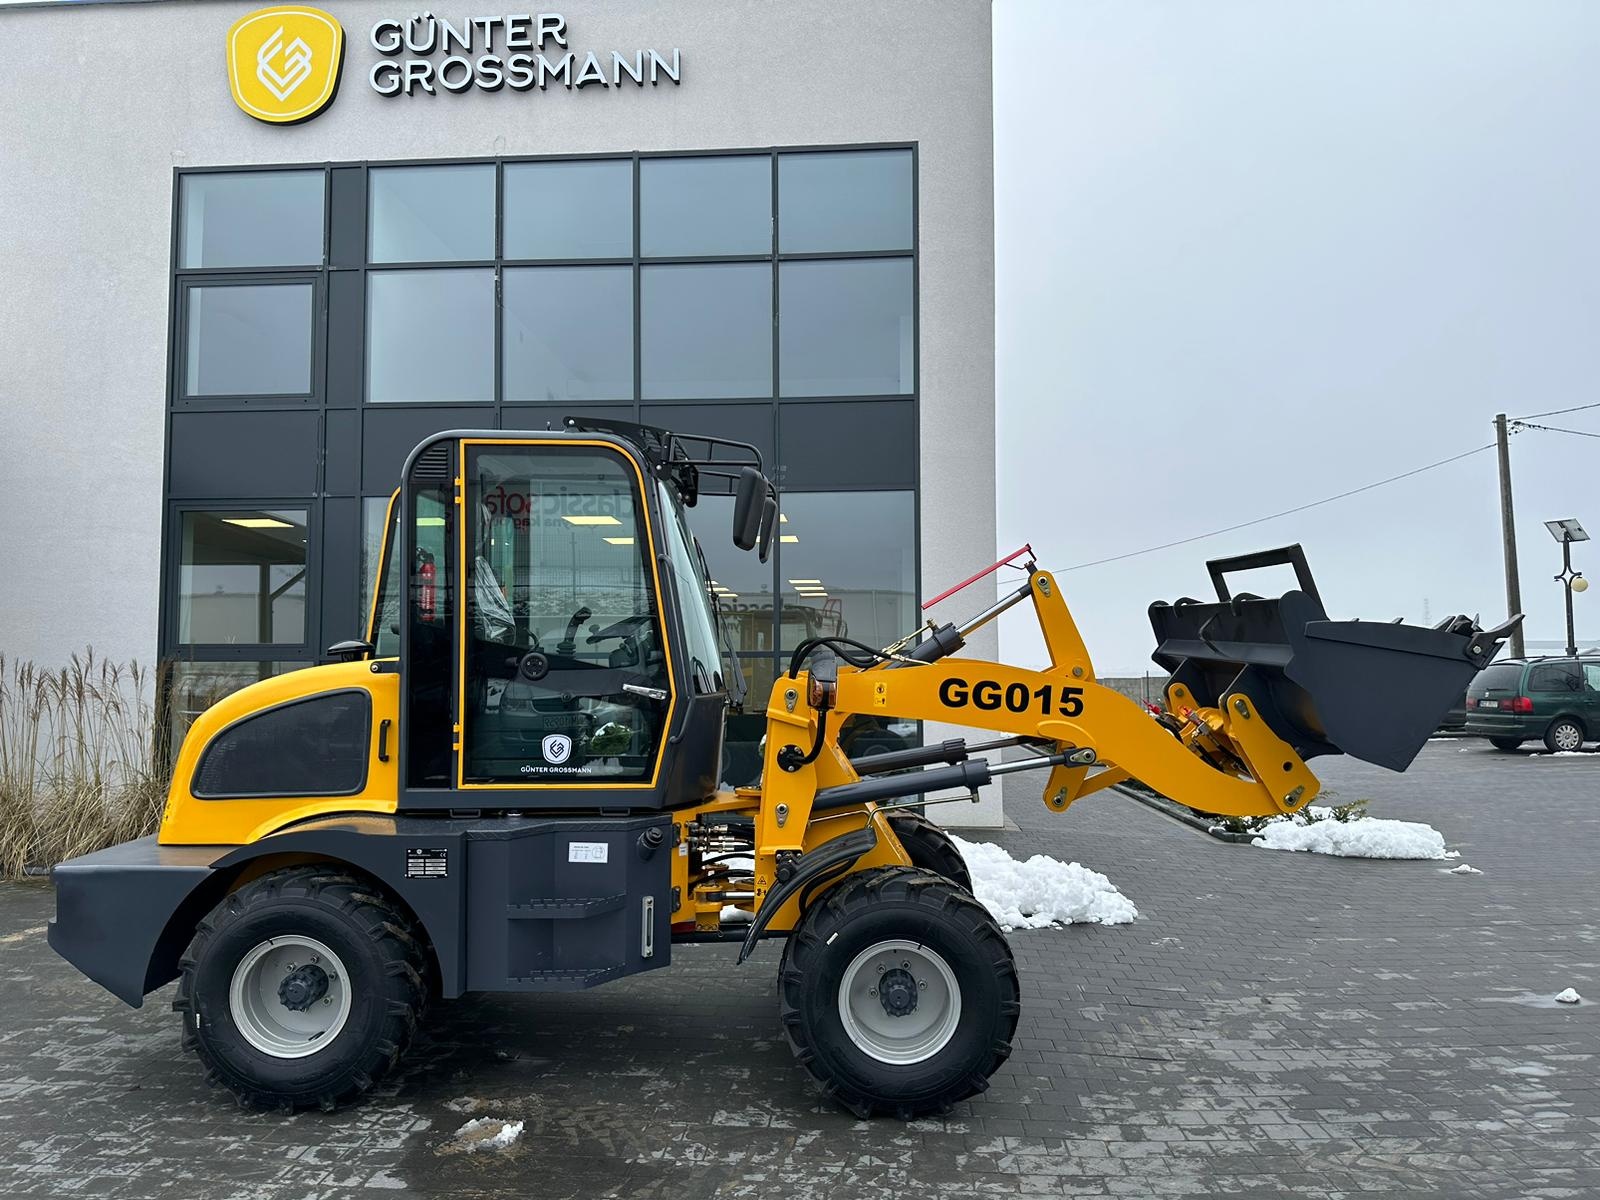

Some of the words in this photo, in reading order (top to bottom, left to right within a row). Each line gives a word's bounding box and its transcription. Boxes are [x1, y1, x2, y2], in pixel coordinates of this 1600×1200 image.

[369, 12, 567, 56] GÜNTER
[369, 48, 682, 96] GROSSMANN
[938, 677, 1084, 717] GG015
[520, 765, 548, 773] GÜNTER
